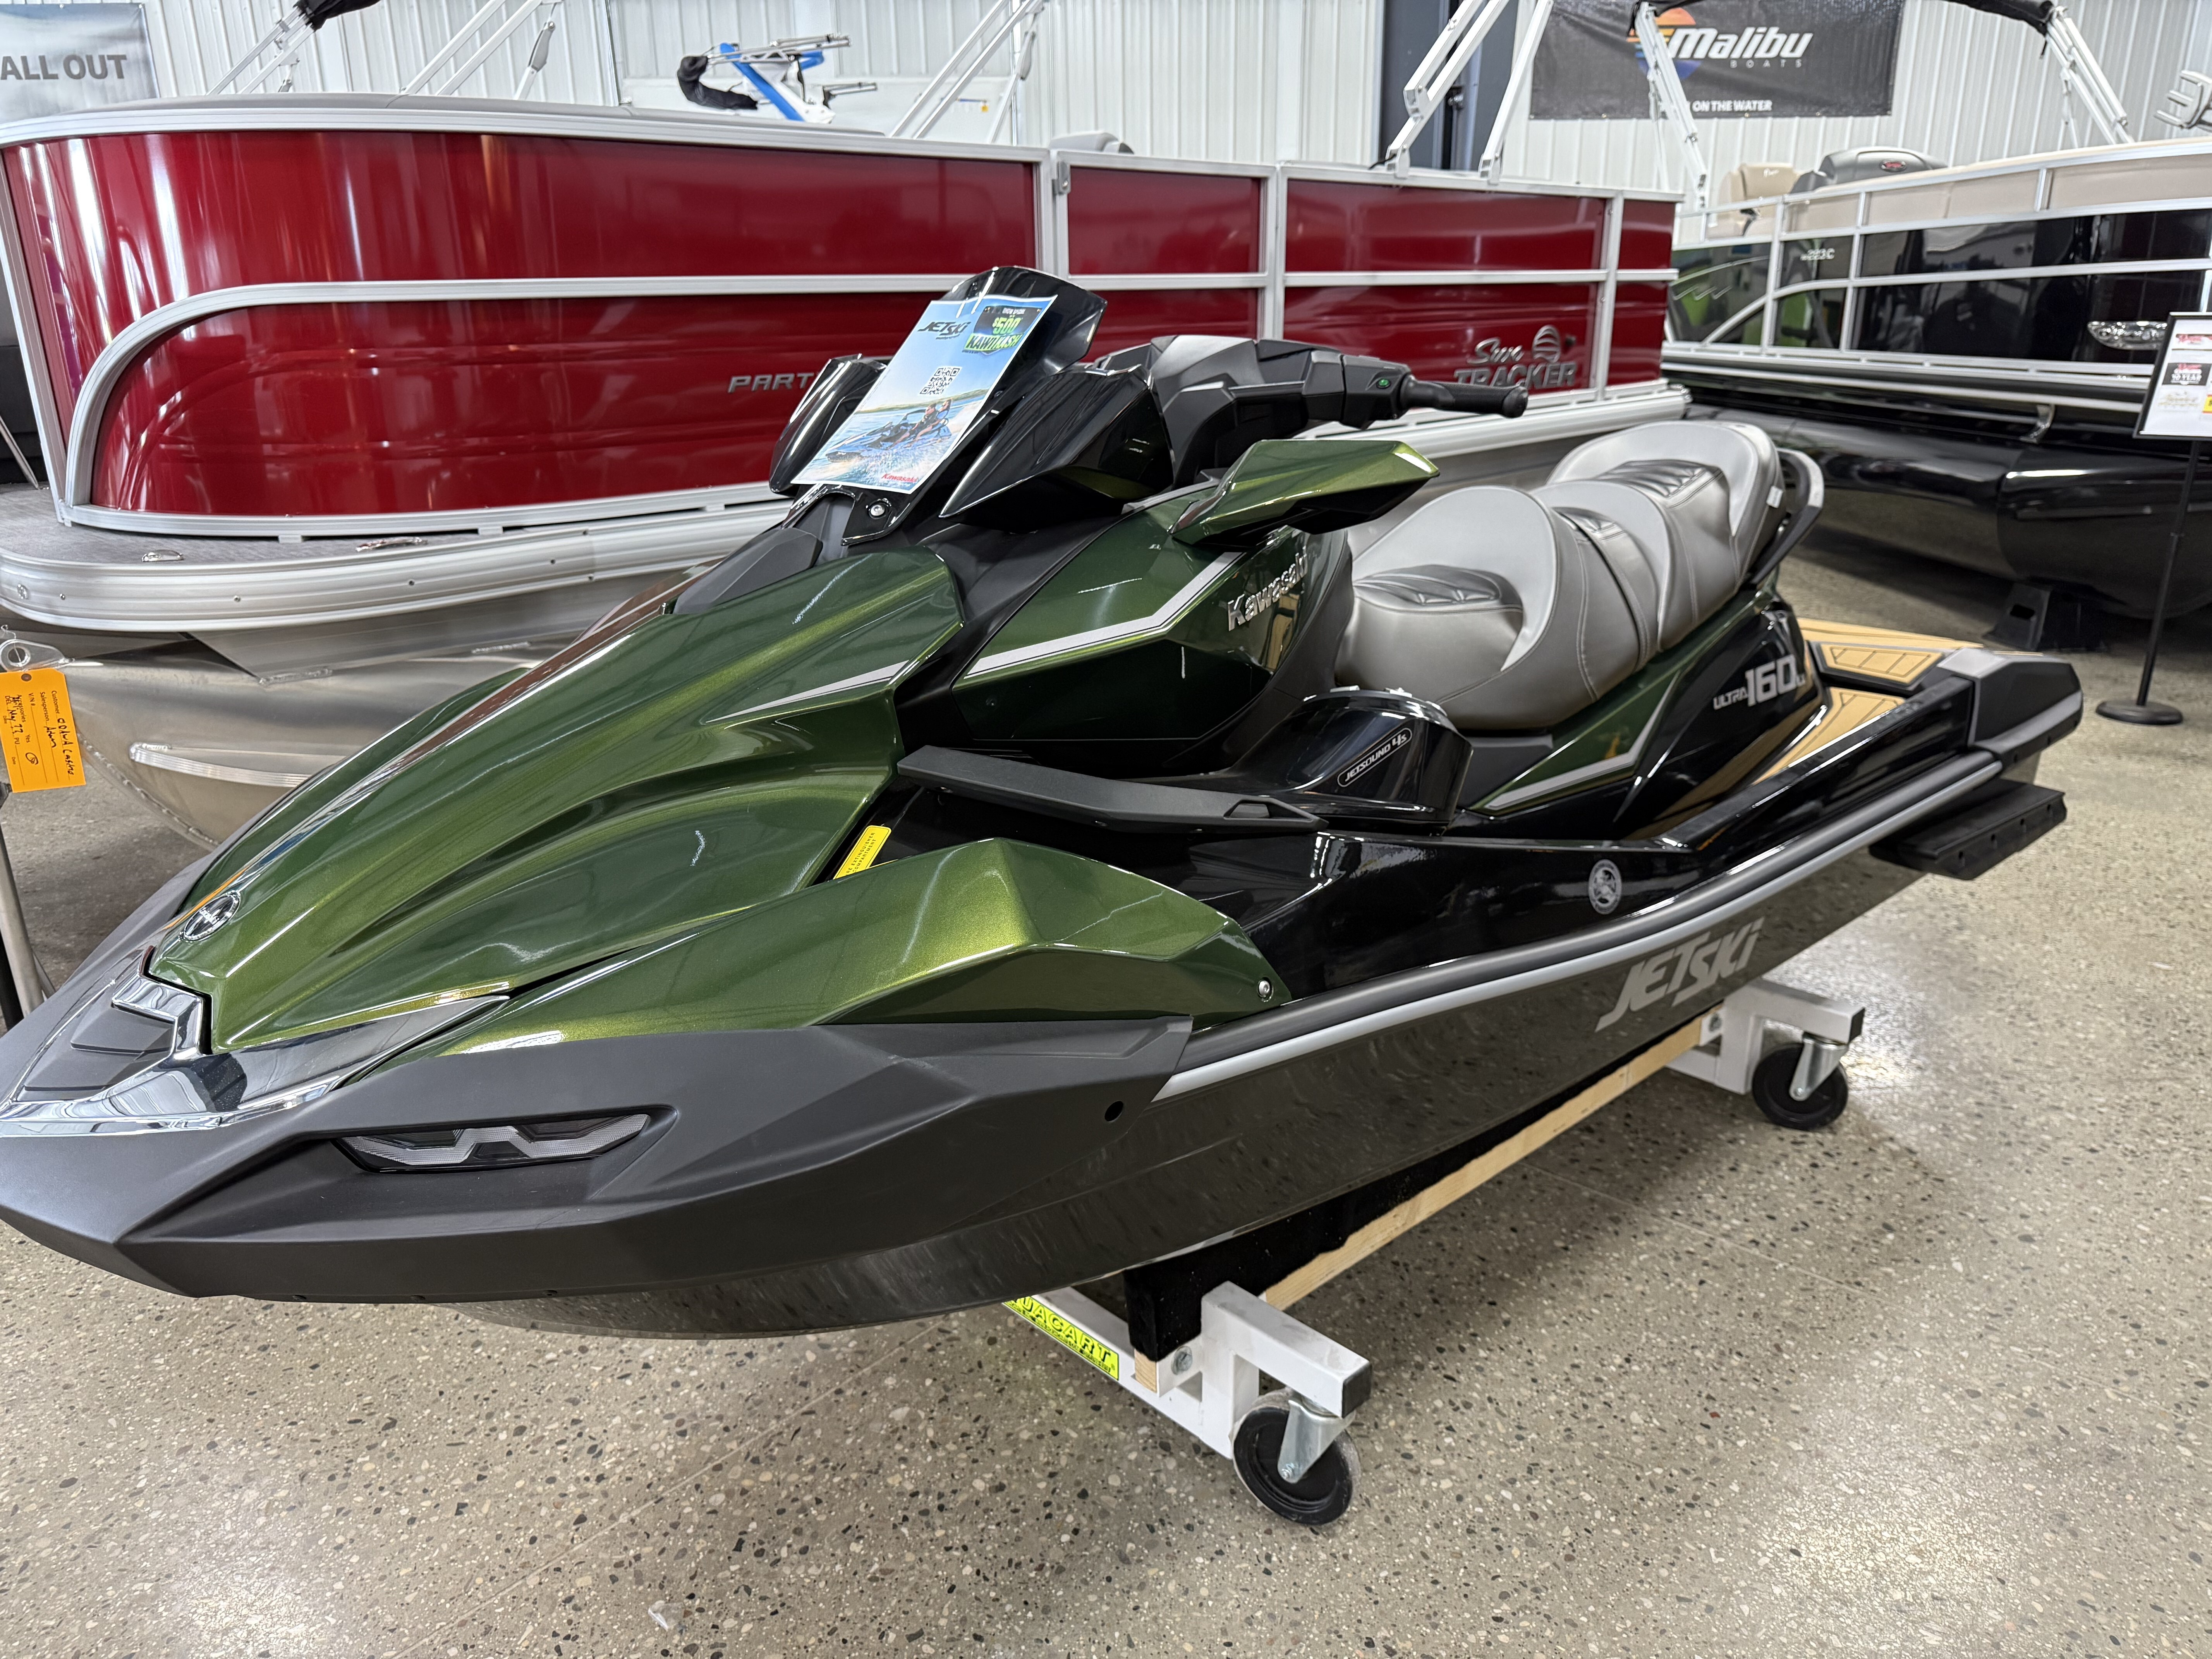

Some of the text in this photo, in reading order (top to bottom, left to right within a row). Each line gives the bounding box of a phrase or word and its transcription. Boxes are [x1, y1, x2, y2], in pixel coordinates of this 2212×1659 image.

[1667, 27, 1814, 59] Malibu
[1, 54, 127, 80] ALL OUT
[1730, 59, 1803, 68] BOATS
[1711, 100, 1733, 112] THE
[1733, 100, 1773, 112] WATER
[728, 373, 814, 393] PART
[1454, 361, 1577, 388] TRACKER
[881, 473, 919, 483] Kawasaki
[1227, 545, 1308, 631] Kawasaki
[40, 692, 49, 721] Salesperson
[51, 690, 60, 714] Customer
[1712, 686, 1748, 710] ULTRA
[1345, 744, 1391, 782] JETSOUND
[852, 833, 876, 866] EXTINGUISHER
[852, 840, 876, 872] COMPARTMENT
[1019, 1297, 1111, 1362] UACART
